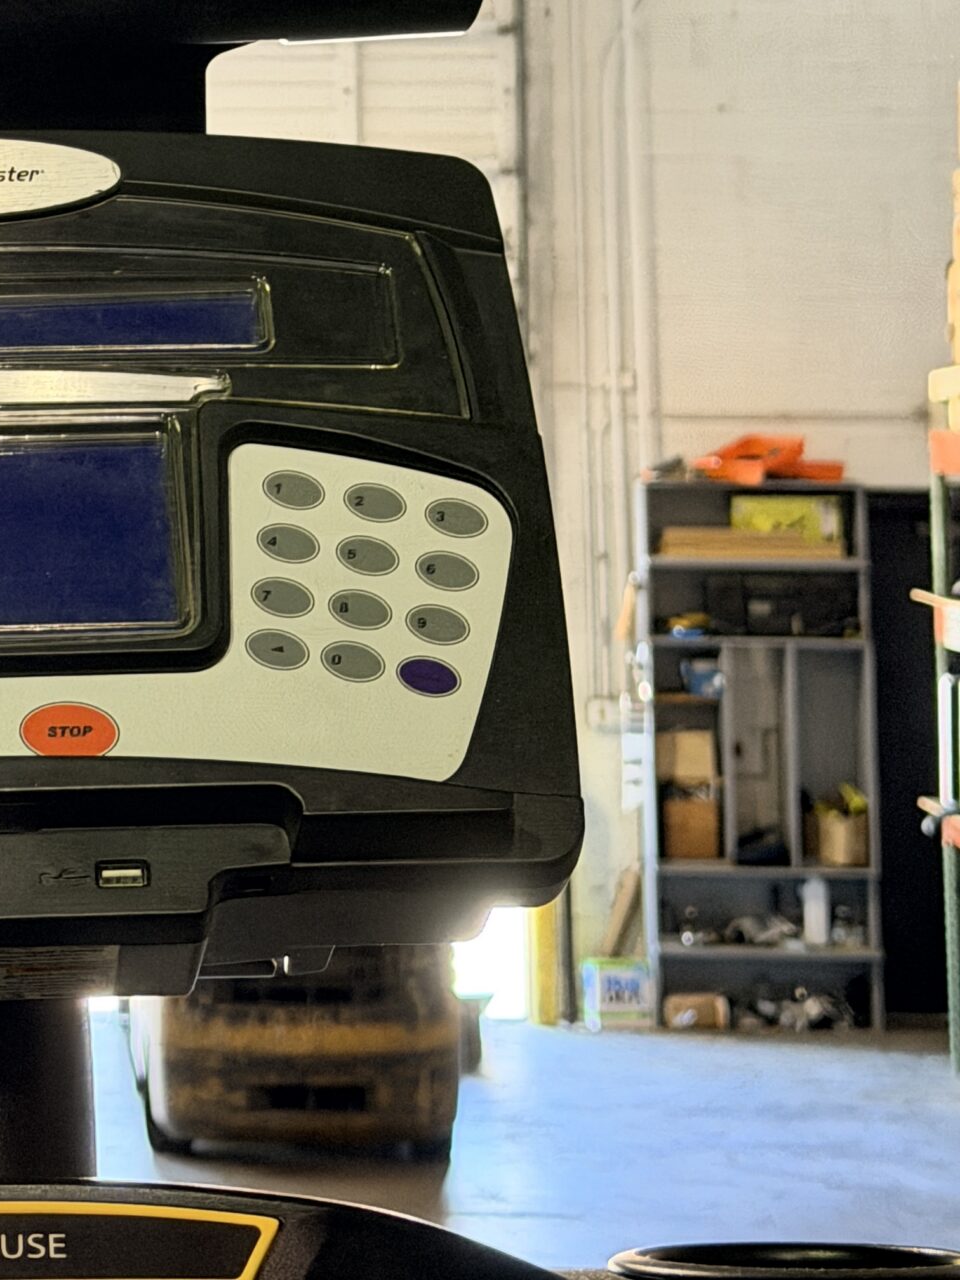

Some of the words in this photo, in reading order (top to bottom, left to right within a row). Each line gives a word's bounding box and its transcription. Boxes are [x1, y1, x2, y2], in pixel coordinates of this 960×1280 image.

[274, 483, 283, 495] 1
[355, 495, 364, 507] 2
[435, 511, 445, 522] 3
[267, 536, 278, 547] 4
[347, 549, 357, 560] 5
[426, 563, 436, 575] 6
[261, 590, 272, 602] 7
[417, 617, 427, 629] 9
[331, 654, 342, 666] 0
[47, 725, 93, 738] STOP
